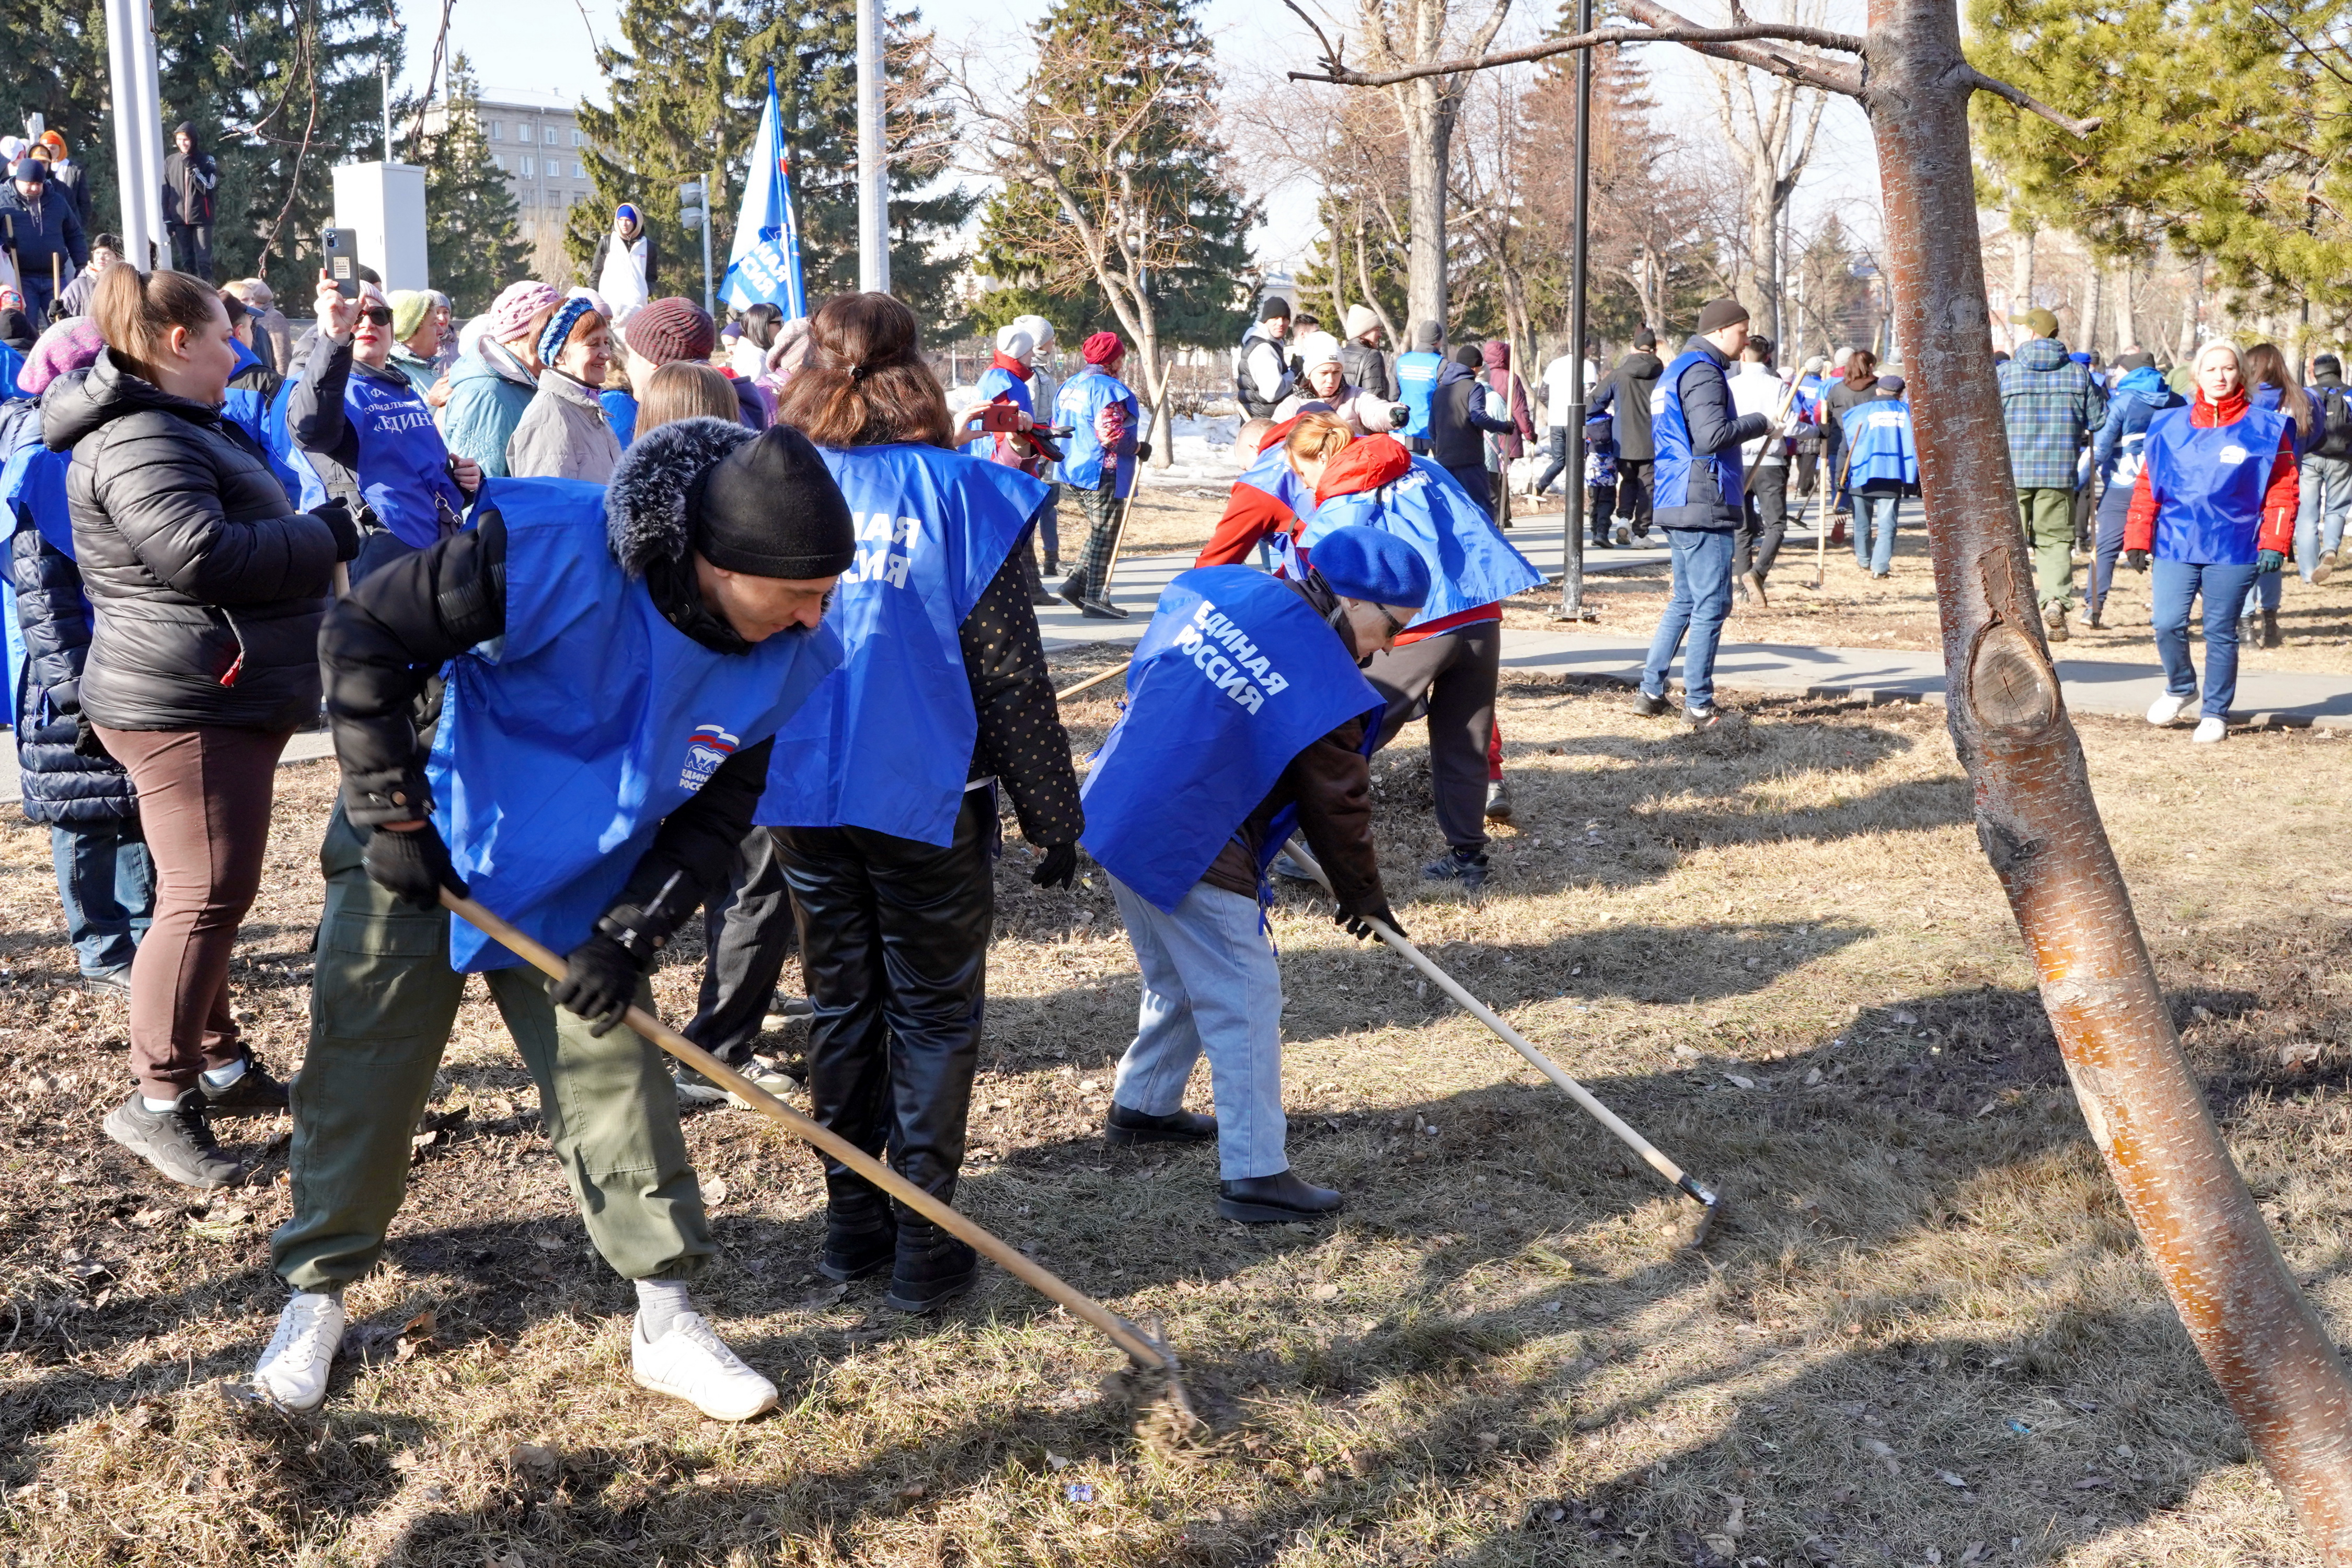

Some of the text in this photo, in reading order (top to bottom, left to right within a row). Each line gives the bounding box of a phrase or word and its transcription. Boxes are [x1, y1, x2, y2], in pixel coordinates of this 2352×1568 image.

[373, 412, 434, 434] «ЕДИН
[1193, 600, 1290, 696] ЕДИНАЯ
[1172, 624, 1265, 716] РОССИЯ
[679, 778, 705, 791] РОСС
[681, 768, 711, 782] ЕДИН
